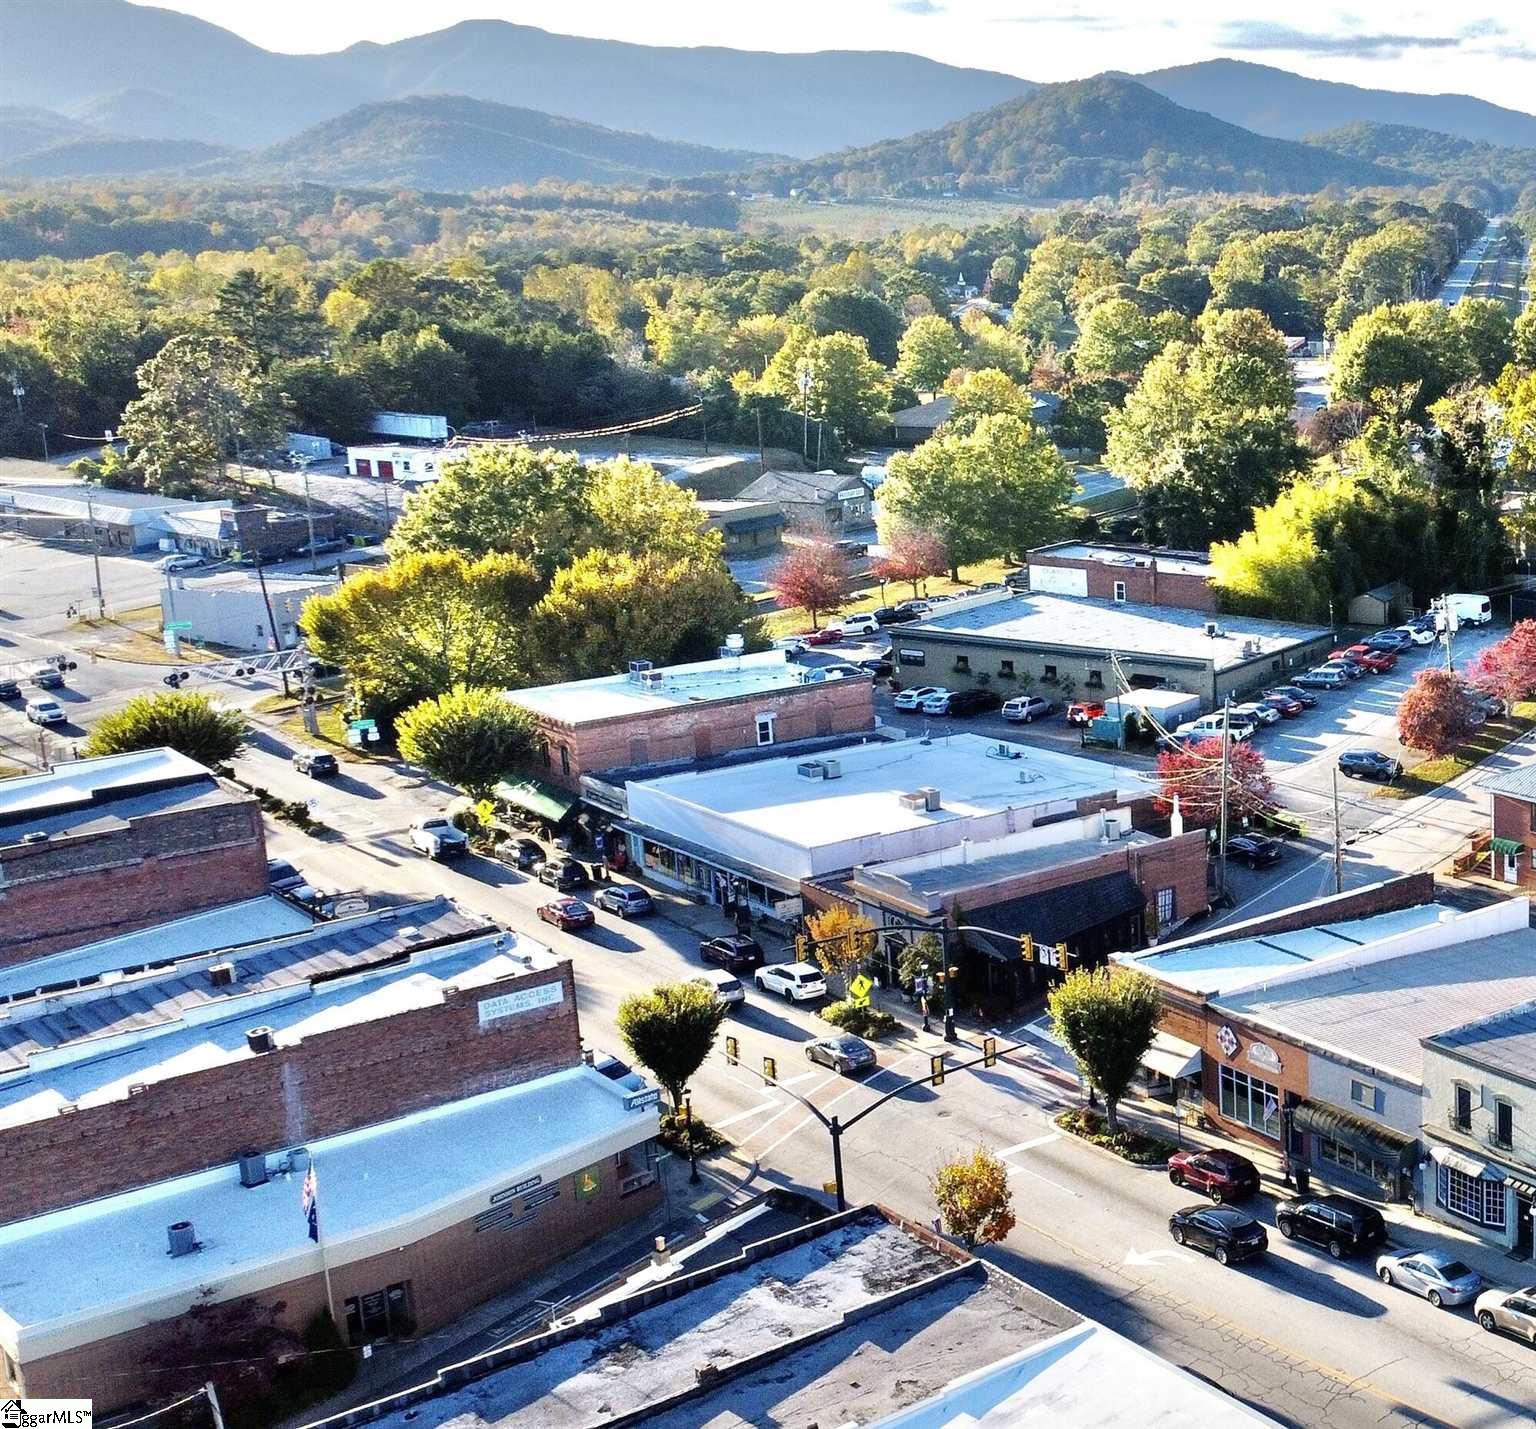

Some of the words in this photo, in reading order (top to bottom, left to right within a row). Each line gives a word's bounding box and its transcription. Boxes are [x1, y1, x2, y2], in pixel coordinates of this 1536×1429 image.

[484, 998, 509, 1010] DATA
[514, 985, 557, 1000] ACCESS
[630, 1092, 658, 1108] Allstate
